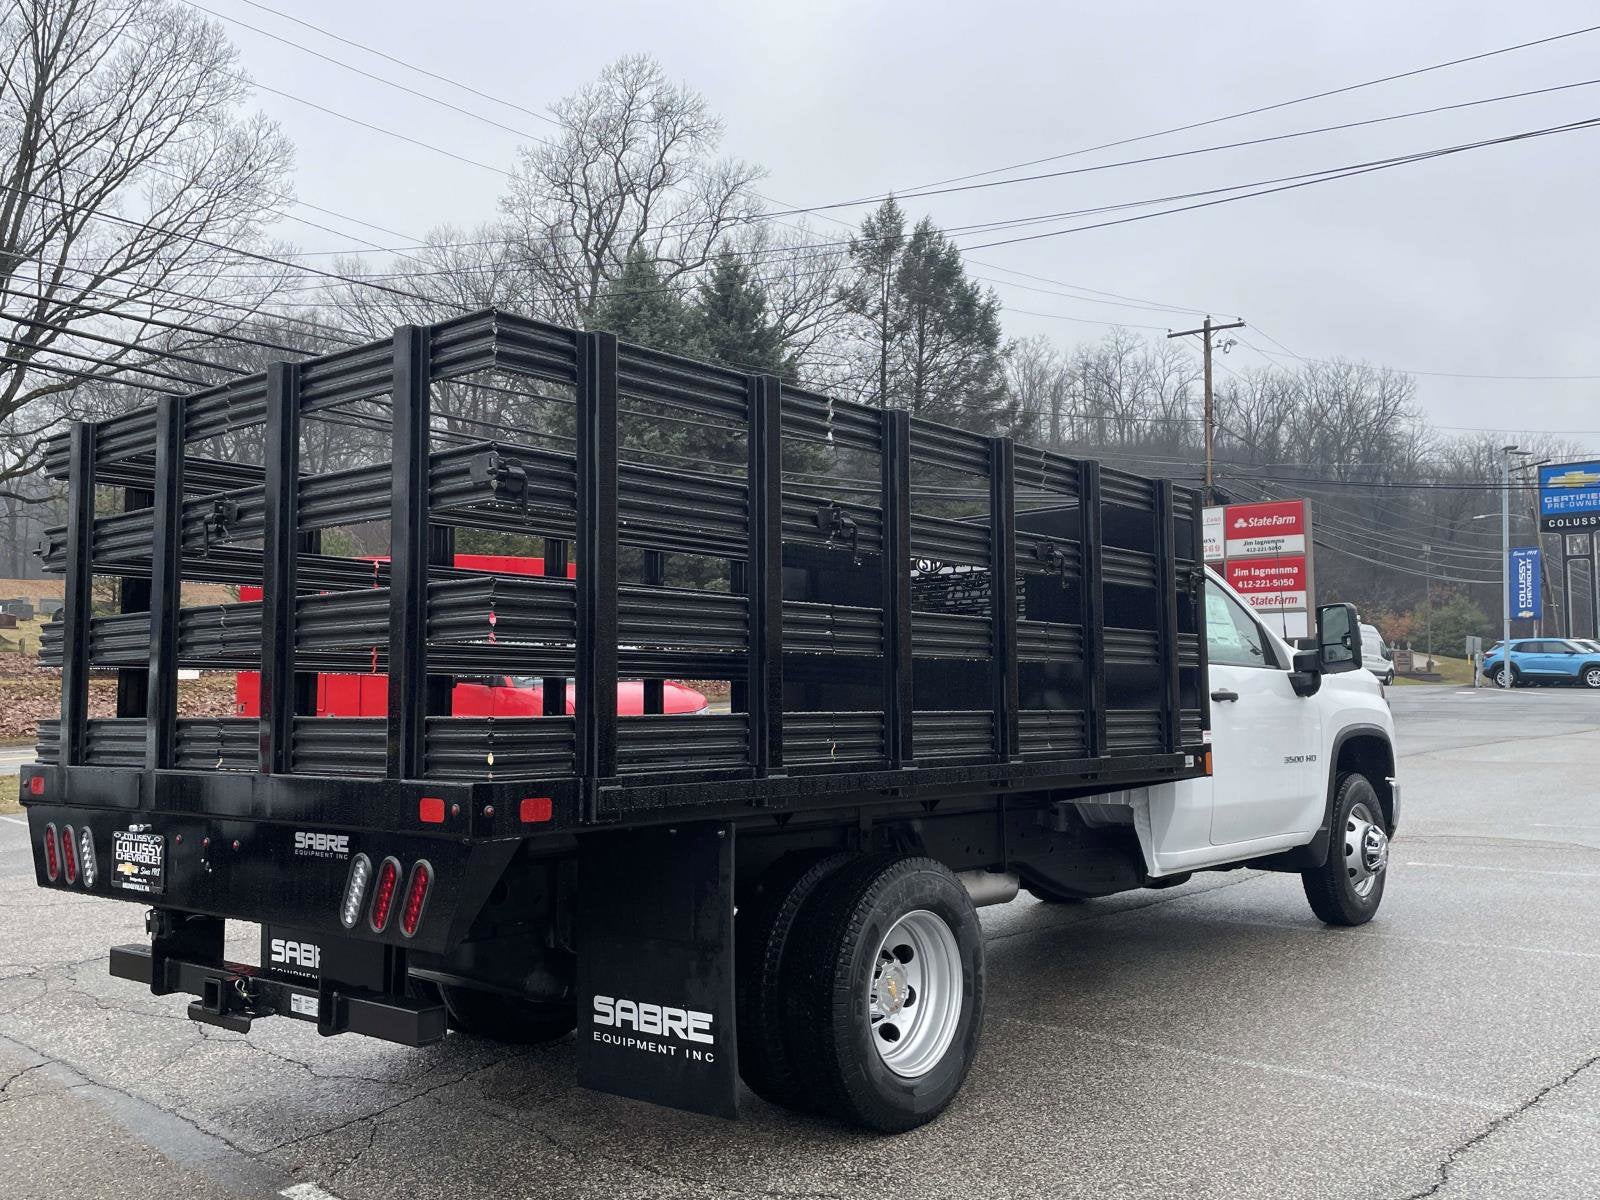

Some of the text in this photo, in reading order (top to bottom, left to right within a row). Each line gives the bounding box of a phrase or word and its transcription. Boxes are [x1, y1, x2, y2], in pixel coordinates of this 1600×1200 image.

[1544, 492, 1600, 503] CERTIFIE
[1547, 499, 1600, 509] PRE-OWNE
[1233, 568, 1249, 577] Jim
[1237, 578, 1295, 588] 412-221-5050
[1519, 558, 1527, 608] COLUSSY
[1283, 755, 1304, 764] 3500
[294, 831, 349, 853] SABRE
[115, 840, 163, 857] COLUSSY
[294, 849, 334, 858] EQUIPMENT
[115, 851, 162, 865] CHEVROLET
[593, 995, 714, 1045] SABRE
[593, 1031, 715, 1063] EQUIPMENT INC
